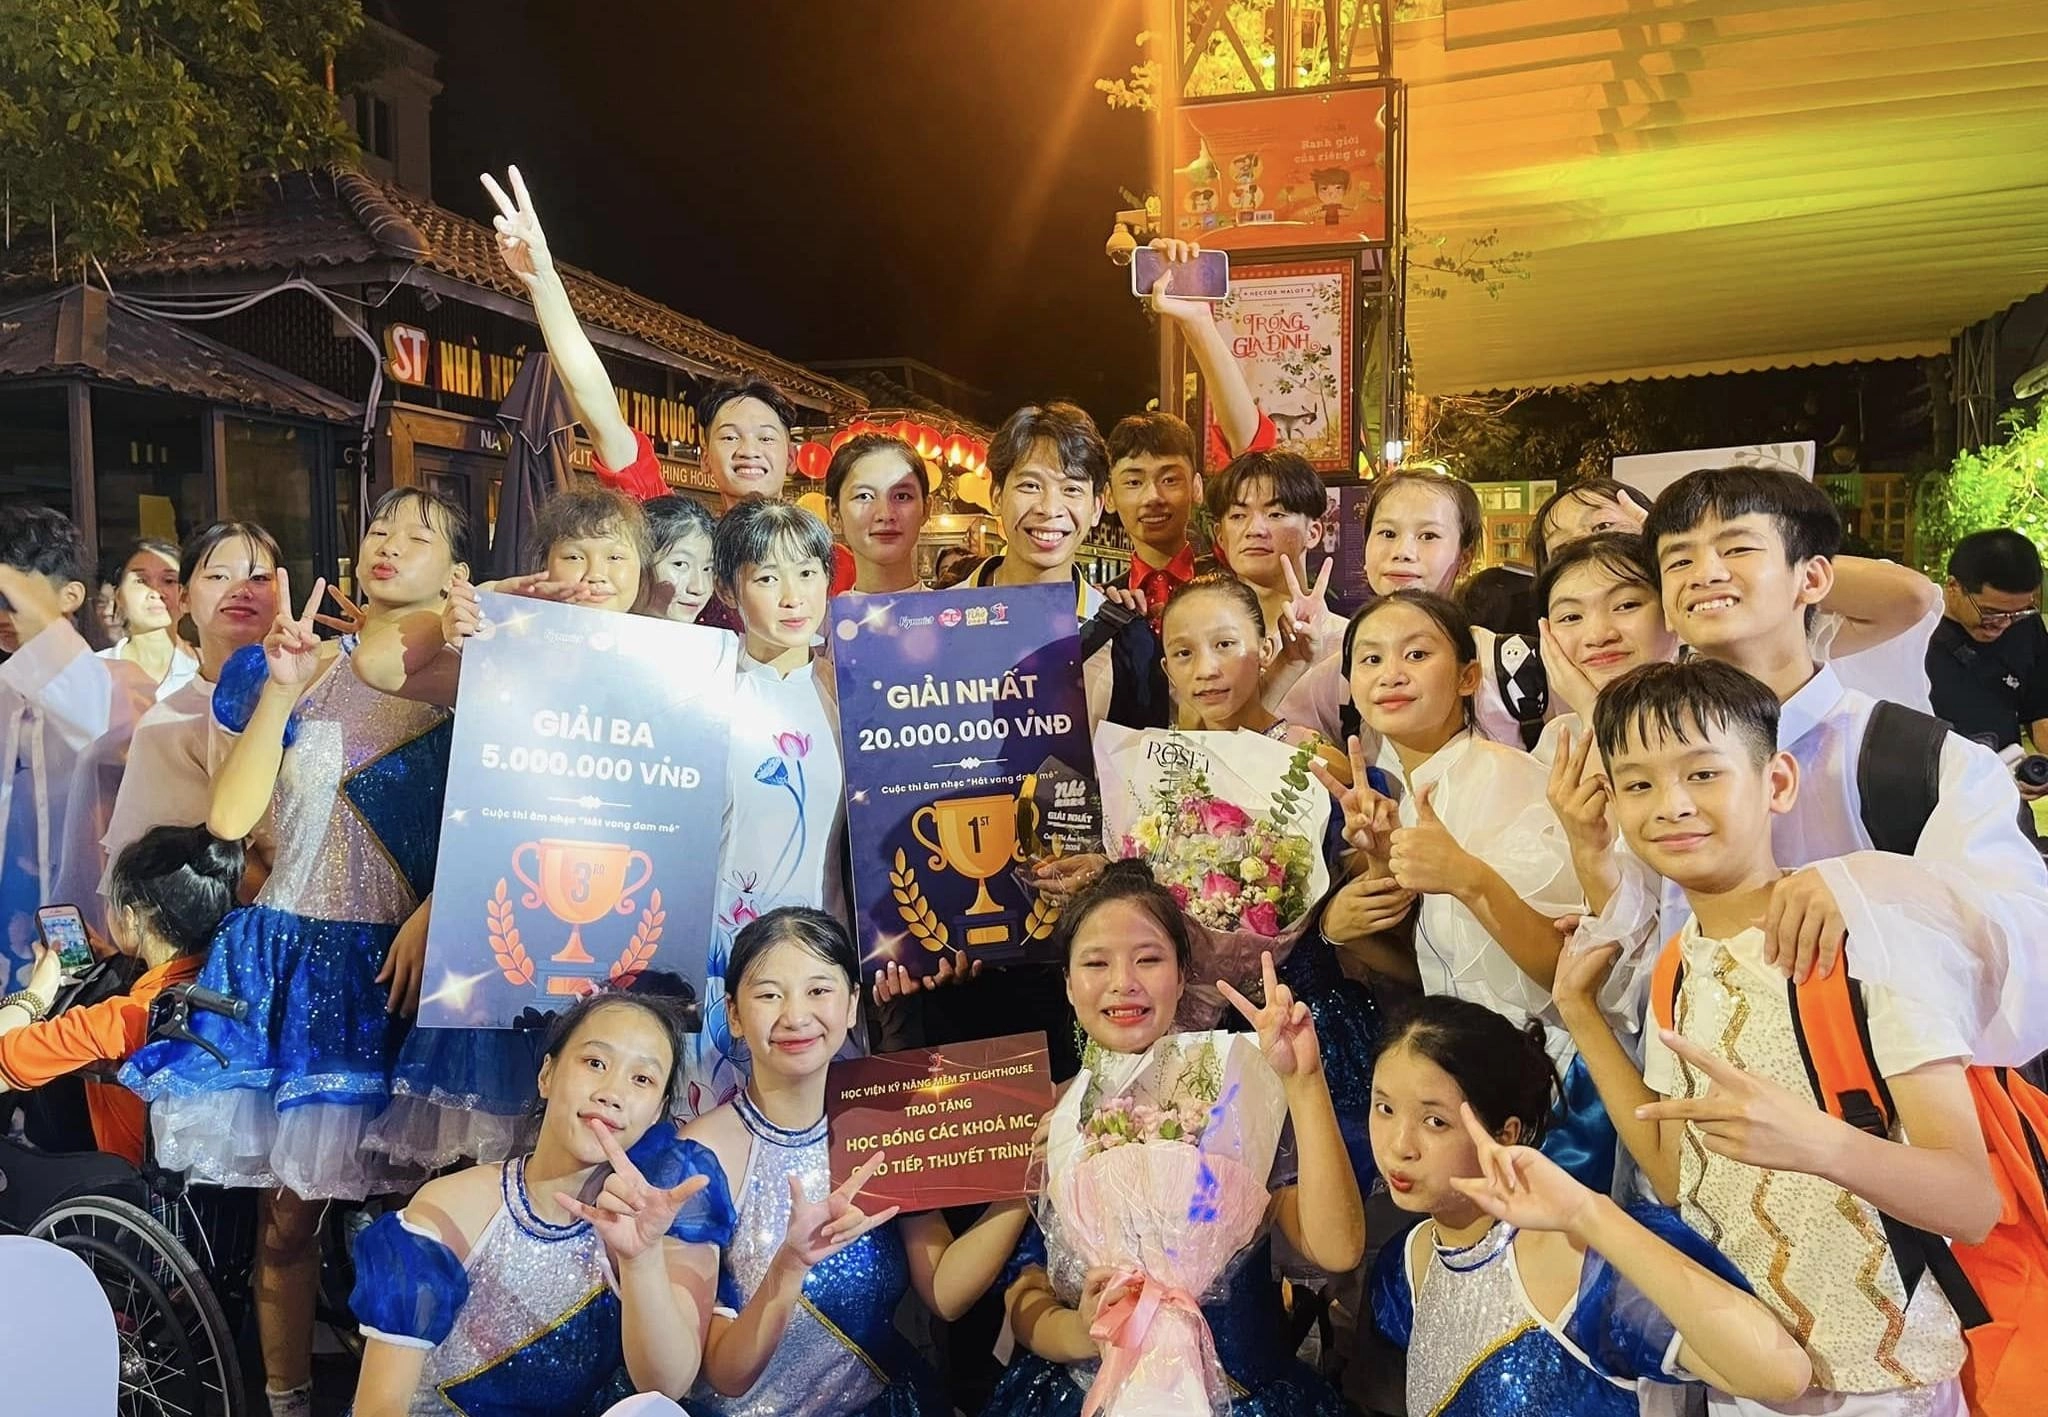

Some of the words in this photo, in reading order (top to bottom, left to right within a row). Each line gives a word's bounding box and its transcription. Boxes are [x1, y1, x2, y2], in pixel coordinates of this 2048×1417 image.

[1249, 289, 1277, 297] HECTOR
[1280, 287, 1304, 295] MALOT
[392, 326, 426, 382] ST
[440, 335, 483, 398] NHÀ
[660, 390, 695, 445] QUỐC
[690, 467, 719, 489] HOUS
[887, 674, 949, 709] GIẢI
[955, 668, 1038, 704] NHẤT
[533, 704, 602, 742] GIẢI
[610, 718, 655, 748] BA
[858, 716, 1010, 751] 20.000.000
[1014, 713, 1072, 738] VNĐ
[481, 743, 633, 782] 5.000.000
[639, 758, 701, 789] VNĐ
[881, 784, 906, 795] Cuộc
[908, 782, 922, 792] thi
[924, 781, 939, 791] âm
[941, 779, 964, 790] nhạc
[990, 775, 1014, 785] vang
[482, 807, 510, 819] Cuộc
[513, 809, 528, 820] thi
[529, 810, 548, 822] âm
[605, 819, 630, 831] vang
[841, 1087, 862, 1100] HỌC
[863, 1084, 886, 1097] VIỆN
[888, 1081, 901, 1094] KỸ
[902, 1077, 931, 1092] NĂNG
[933, 1074, 956, 1087] MỀM
[959, 1072, 971, 1083] ST
[973, 1064, 1034, 1082] LIGHTHOUSE
[905, 1103, 937, 1118] TRAO
[939, 1098, 973, 1114] TẶNG
[846, 1134, 878, 1153] HỌC
[882, 1127, 925, 1147] BỔNG
[929, 1120, 958, 1140] CÁC
[962, 1114, 1006, 1136] KHOÁ
[1009, 1112, 1038, 1130] MC,
[892, 1154, 923, 1174] TIẾP,
[928, 1146, 985, 1169] THUYẾT
[988, 1142, 1035, 1162] TRÌNH
